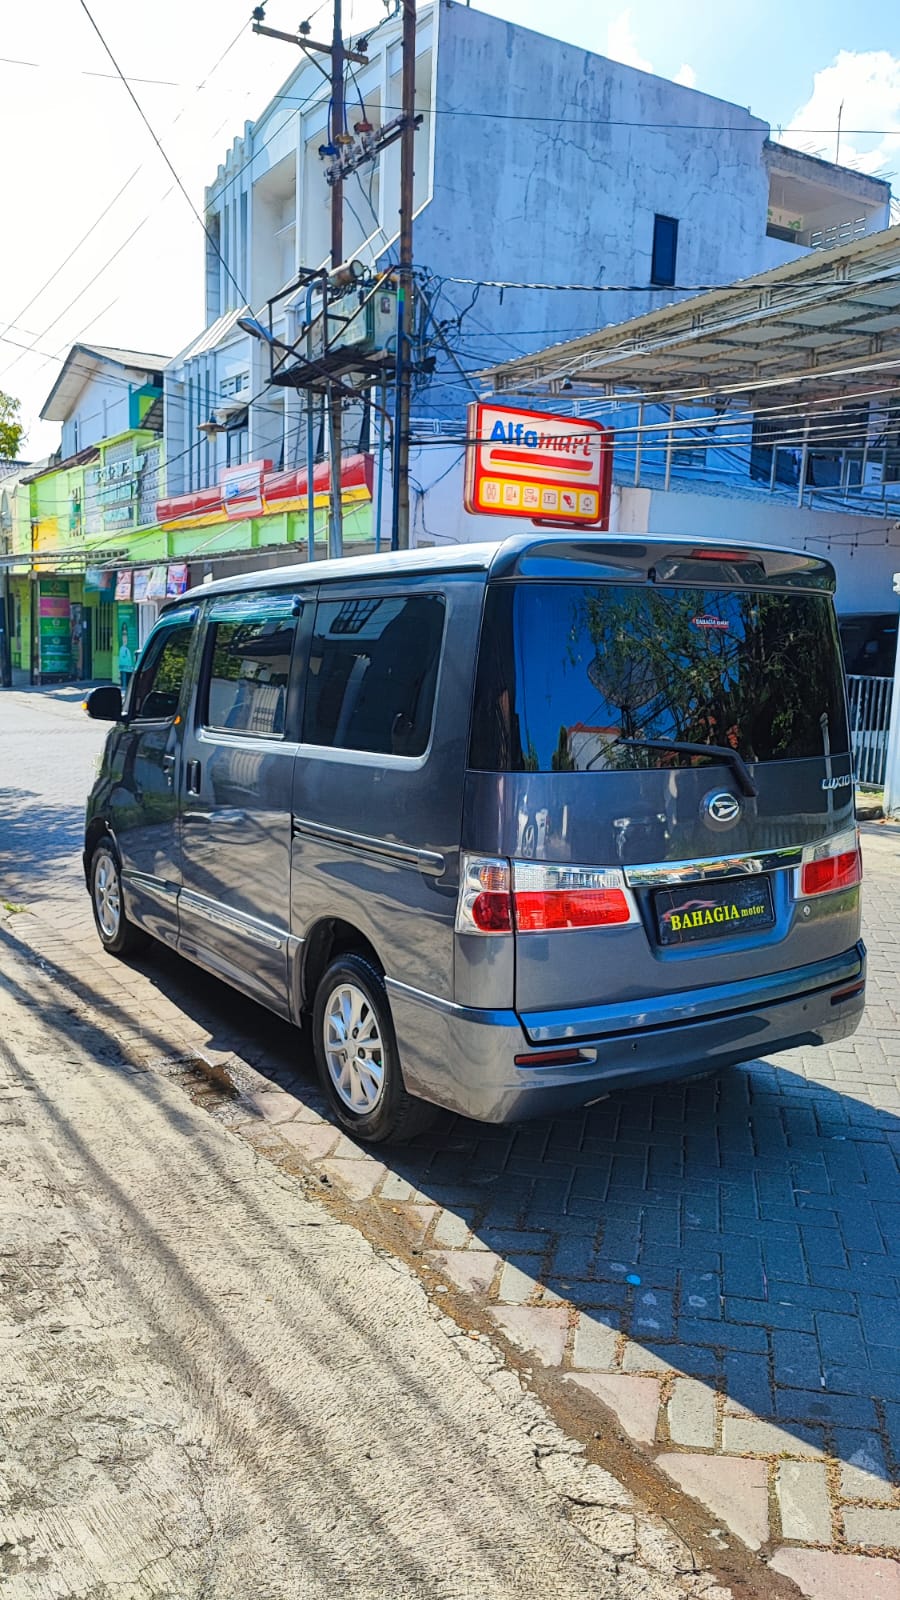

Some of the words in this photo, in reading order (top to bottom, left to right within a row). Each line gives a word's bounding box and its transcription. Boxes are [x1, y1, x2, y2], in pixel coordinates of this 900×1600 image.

[490, 420, 592, 456] Alfamart
[670, 904, 740, 931] BAHAGIA
[741, 905, 765, 917] motor
